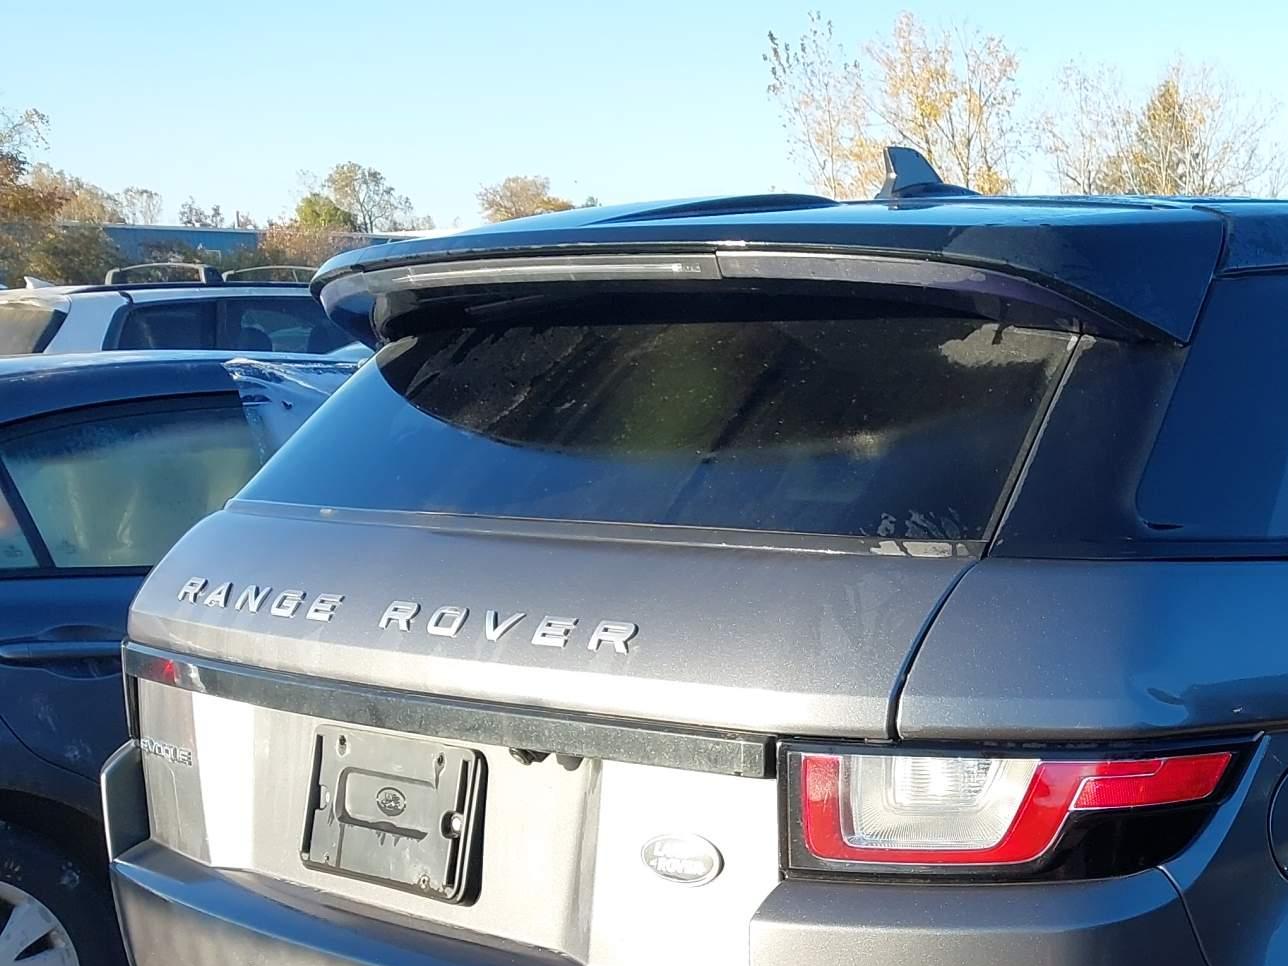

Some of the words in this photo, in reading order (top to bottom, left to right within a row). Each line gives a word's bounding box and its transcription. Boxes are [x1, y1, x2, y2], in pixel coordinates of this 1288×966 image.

[177, 576, 345, 622] RANGE
[378, 600, 640, 656] ROVER
[140, 737, 193, 768] EVOQUE
